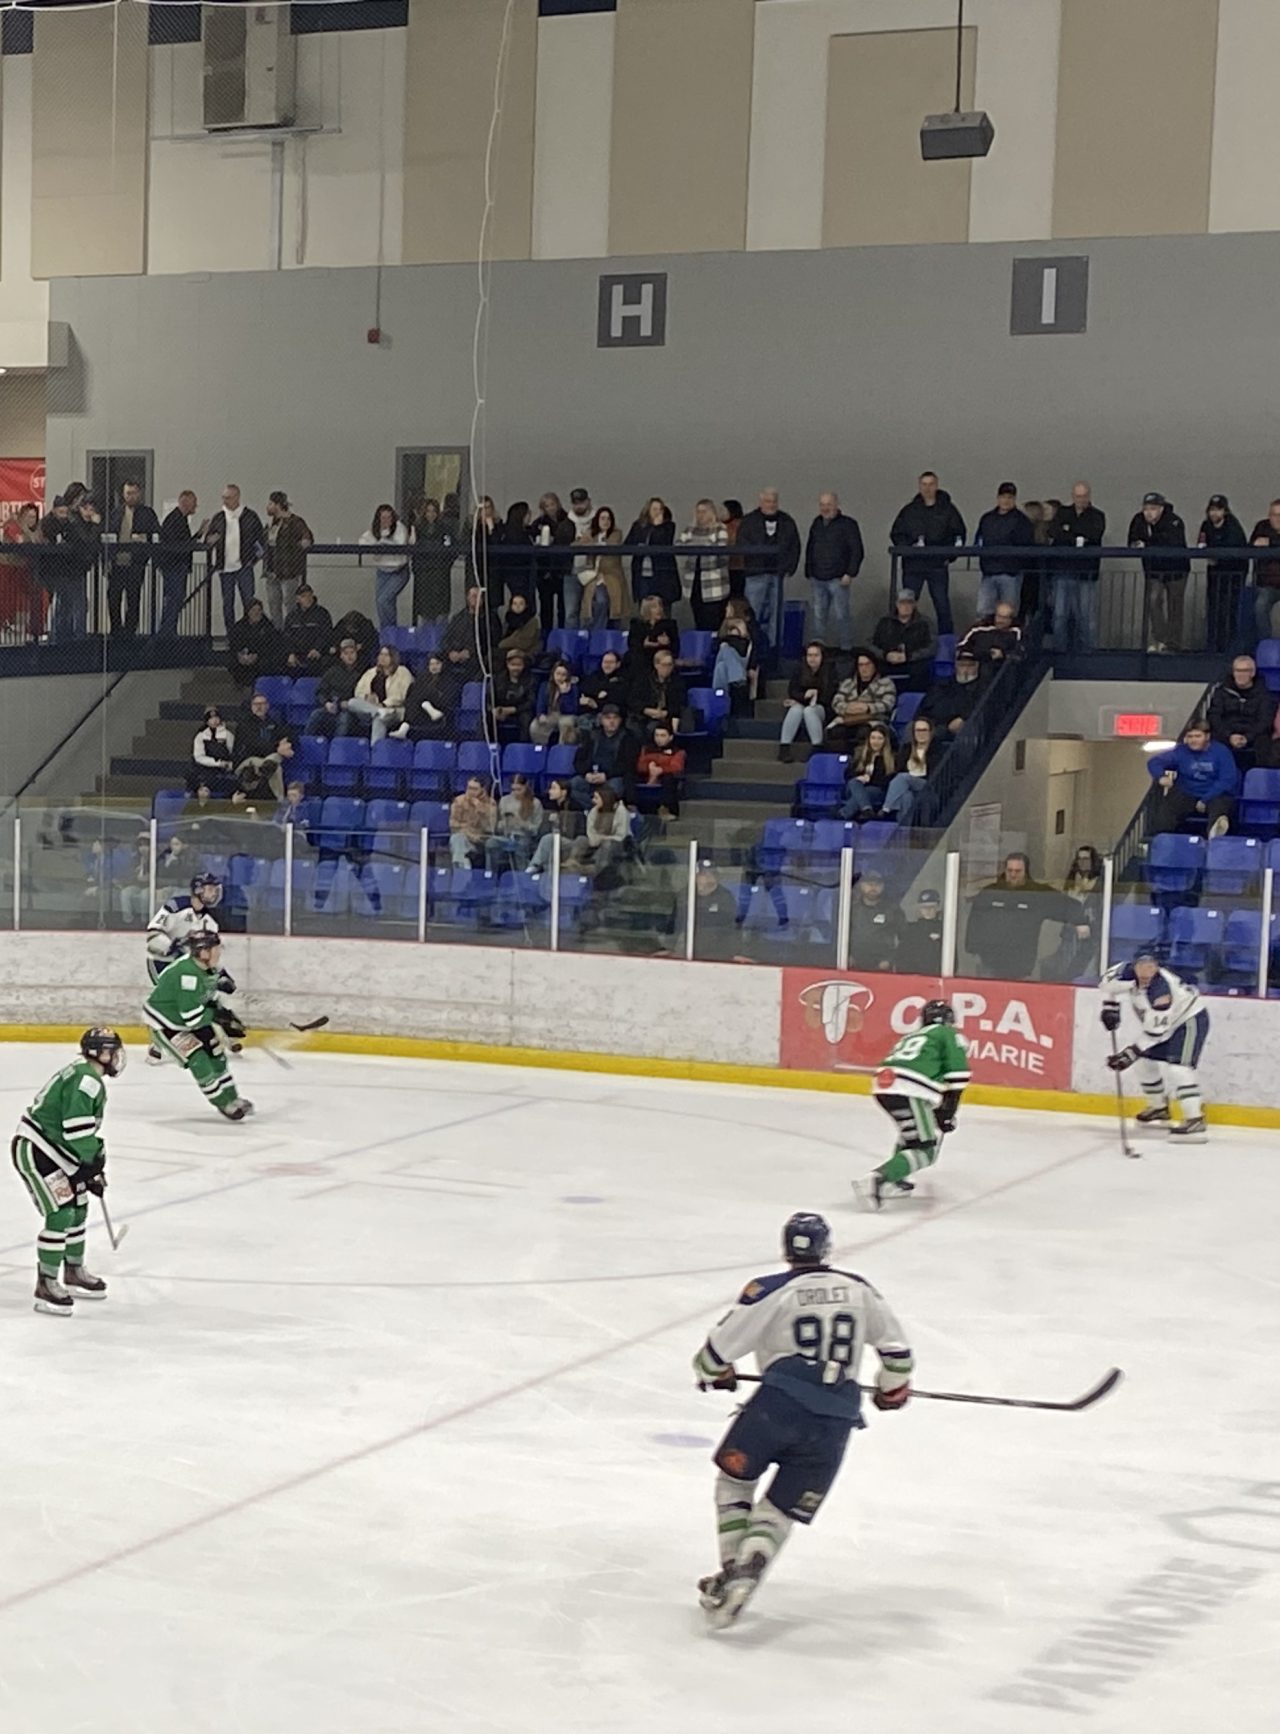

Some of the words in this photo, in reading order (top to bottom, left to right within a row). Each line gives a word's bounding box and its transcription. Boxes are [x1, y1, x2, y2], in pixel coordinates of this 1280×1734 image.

[610, 283, 653, 338] H
[1041, 267, 1058, 324] I
[32, 476, 46, 489] ST
[1153, 1015, 1169, 1029] 14
[797, 1285, 850, 1307] DROLET
[793, 1313, 855, 1366] 98
